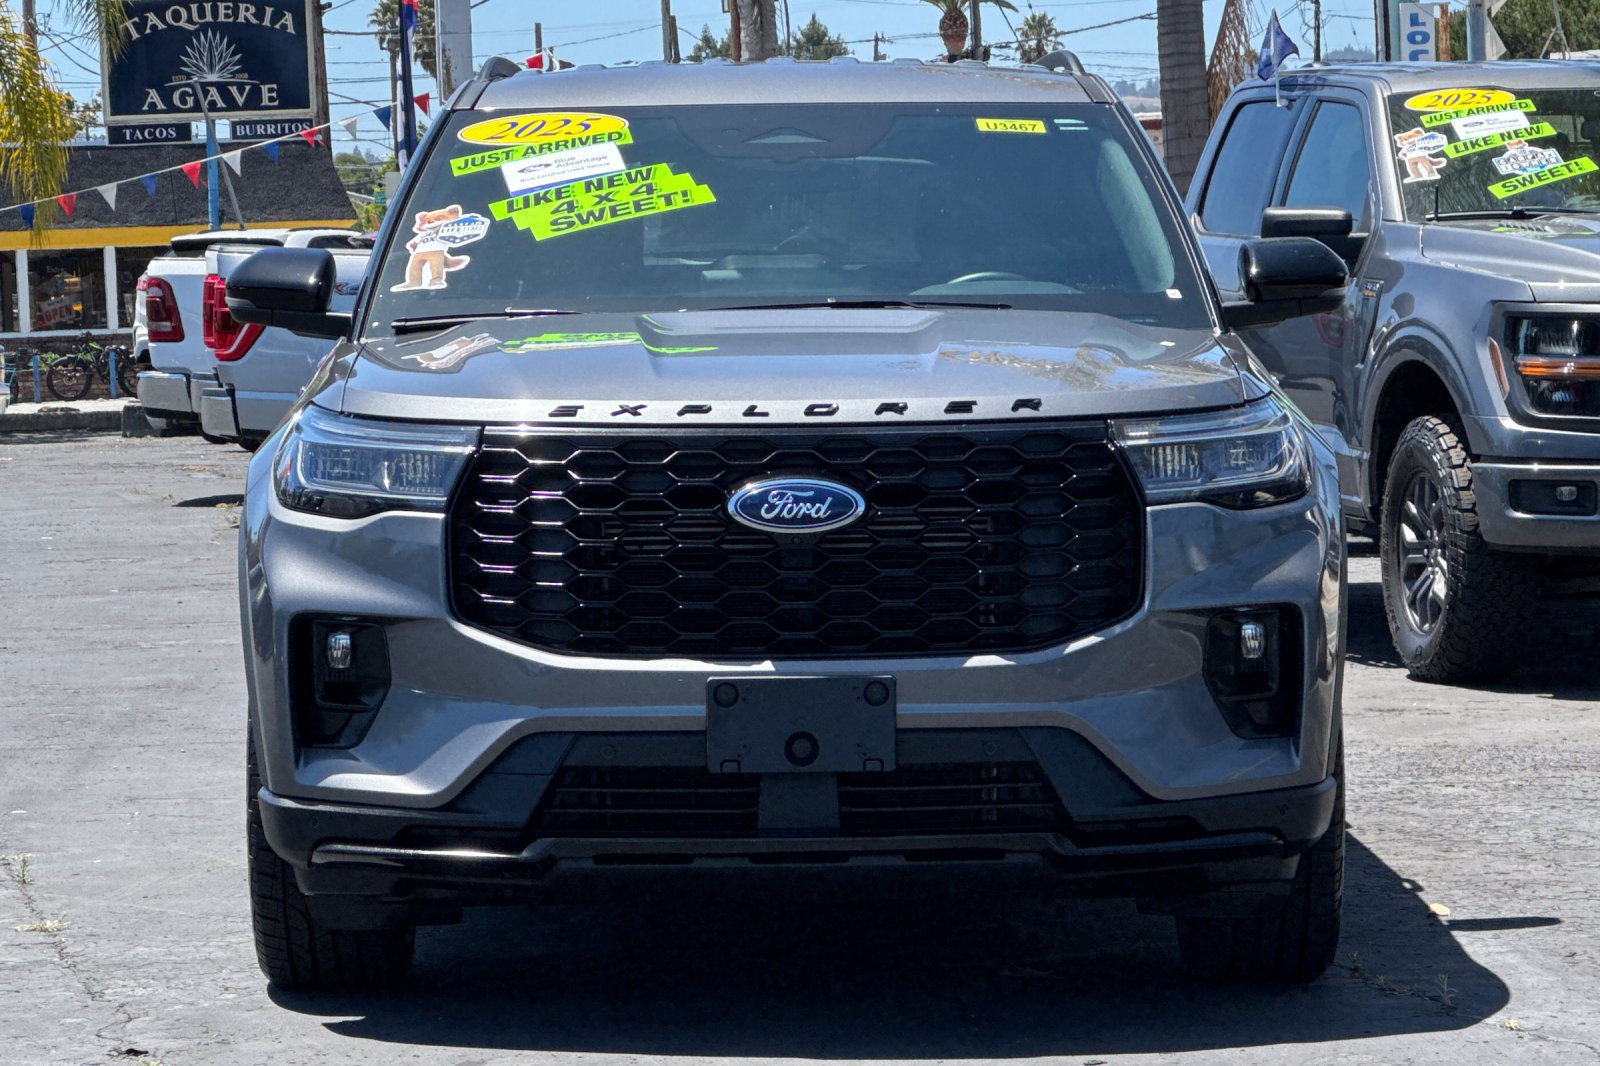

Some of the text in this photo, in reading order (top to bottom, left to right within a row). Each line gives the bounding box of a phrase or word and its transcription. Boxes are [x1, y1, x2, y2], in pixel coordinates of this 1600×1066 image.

[122, 2, 297, 41] TAQUERIA
[142, 83, 280, 111] AGAVE
[1425, 92, 1496, 108] 2025
[985, 121, 1038, 132] U3467
[1425, 101, 1530, 124] JUST ARRIVED
[123, 127, 177, 141] TACOS
[236, 121, 311, 137] BURRITOS
[484, 117, 602, 140] 2025
[1453, 136, 1494, 154] LIKE
[1501, 124, 1543, 142] NEW
[456, 131, 624, 171] JUST ARRIVED
[556, 155, 608, 169] Advantage
[506, 167, 654, 213] LIKE NEW
[1501, 161, 1585, 193] SWEET!
[549, 189, 693, 232] SWEET!
[550, 199, 579, 215] 4
[629, 182, 658, 197] 4
[548, 397, 1043, 418] EXPLORER
[760, 490, 833, 519] Ford
